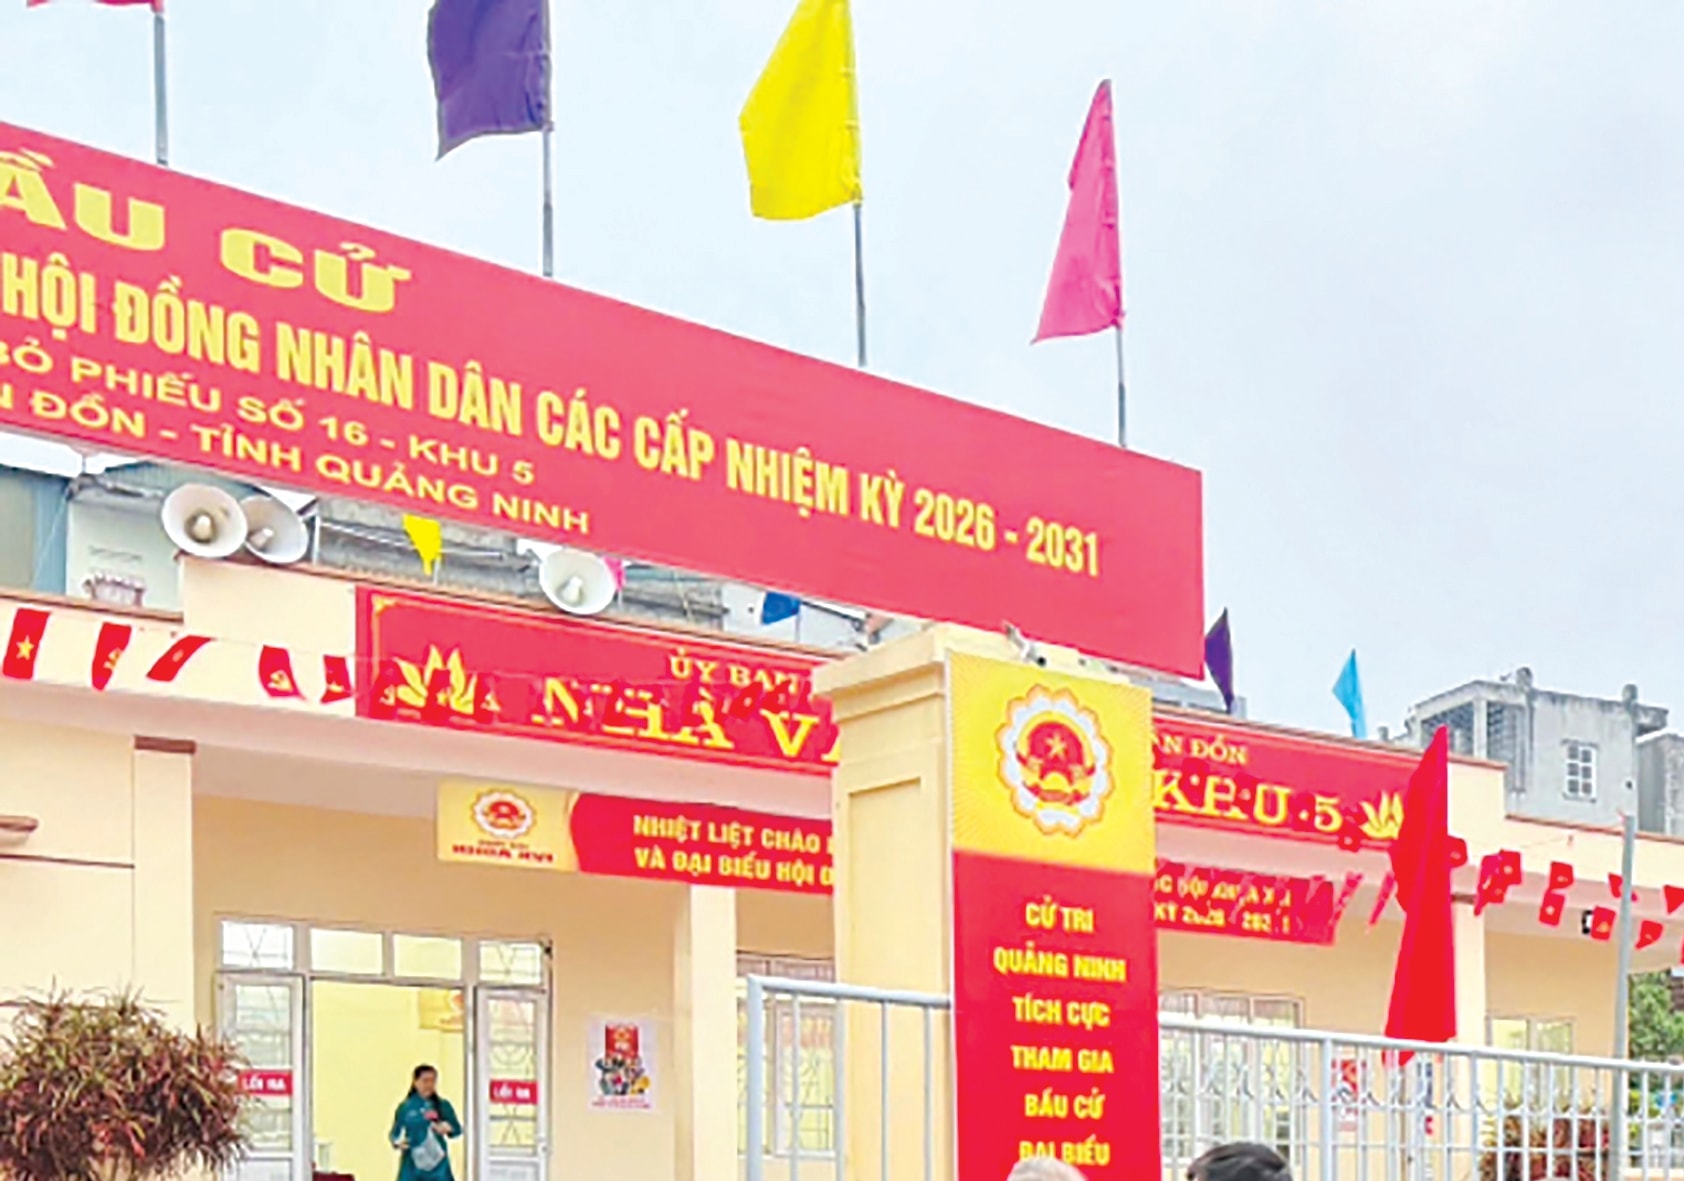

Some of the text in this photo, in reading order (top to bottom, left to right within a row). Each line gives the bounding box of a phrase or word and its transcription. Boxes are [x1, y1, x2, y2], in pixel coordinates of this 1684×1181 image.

[220, 227, 411, 313] CỬ
[2, 252, 1100, 576] HỘI ĐỒNG NHÂN DÂN CÁC CẤP NHIỆM KỲ 2026 - 2031
[71, 356, 222, 414] PHIẾU
[238, 396, 304, 432] SỐ
[319, 416, 368, 448] 16
[379, 440, 395, 450] -
[409, 436, 500, 477] KHU
[511, 460, 534, 485] 5
[31, 392, 146, 438] ĐỒN
[160, 428, 178, 440] -
[191, 422, 302, 472] TỈNH
[316, 452, 479, 511] QUẢNG
[492, 493, 590, 536] NINH
[669, 646, 718, 684] ỦY
[1314, 793, 1344, 833] 5
[634, 814, 821, 855] NHIỆT LIỆT CHÀO
[634, 843, 666, 870] VÀ
[672, 852, 712, 877] ĐẠI
[719, 849, 771, 881] BIỂU
[776, 857, 815, 887] HỘI
[1026, 894, 1095, 934] CỬ TRI
[993, 941, 1127, 983] QUẢNG NINH
[1013, 991, 1111, 1031] TÍCH CỰC
[1011, 1045, 1115, 1074] THAM GIA
[1074, 1086, 1107, 1120] CỬ
[1061, 1134, 1111, 1166] BIỂU
